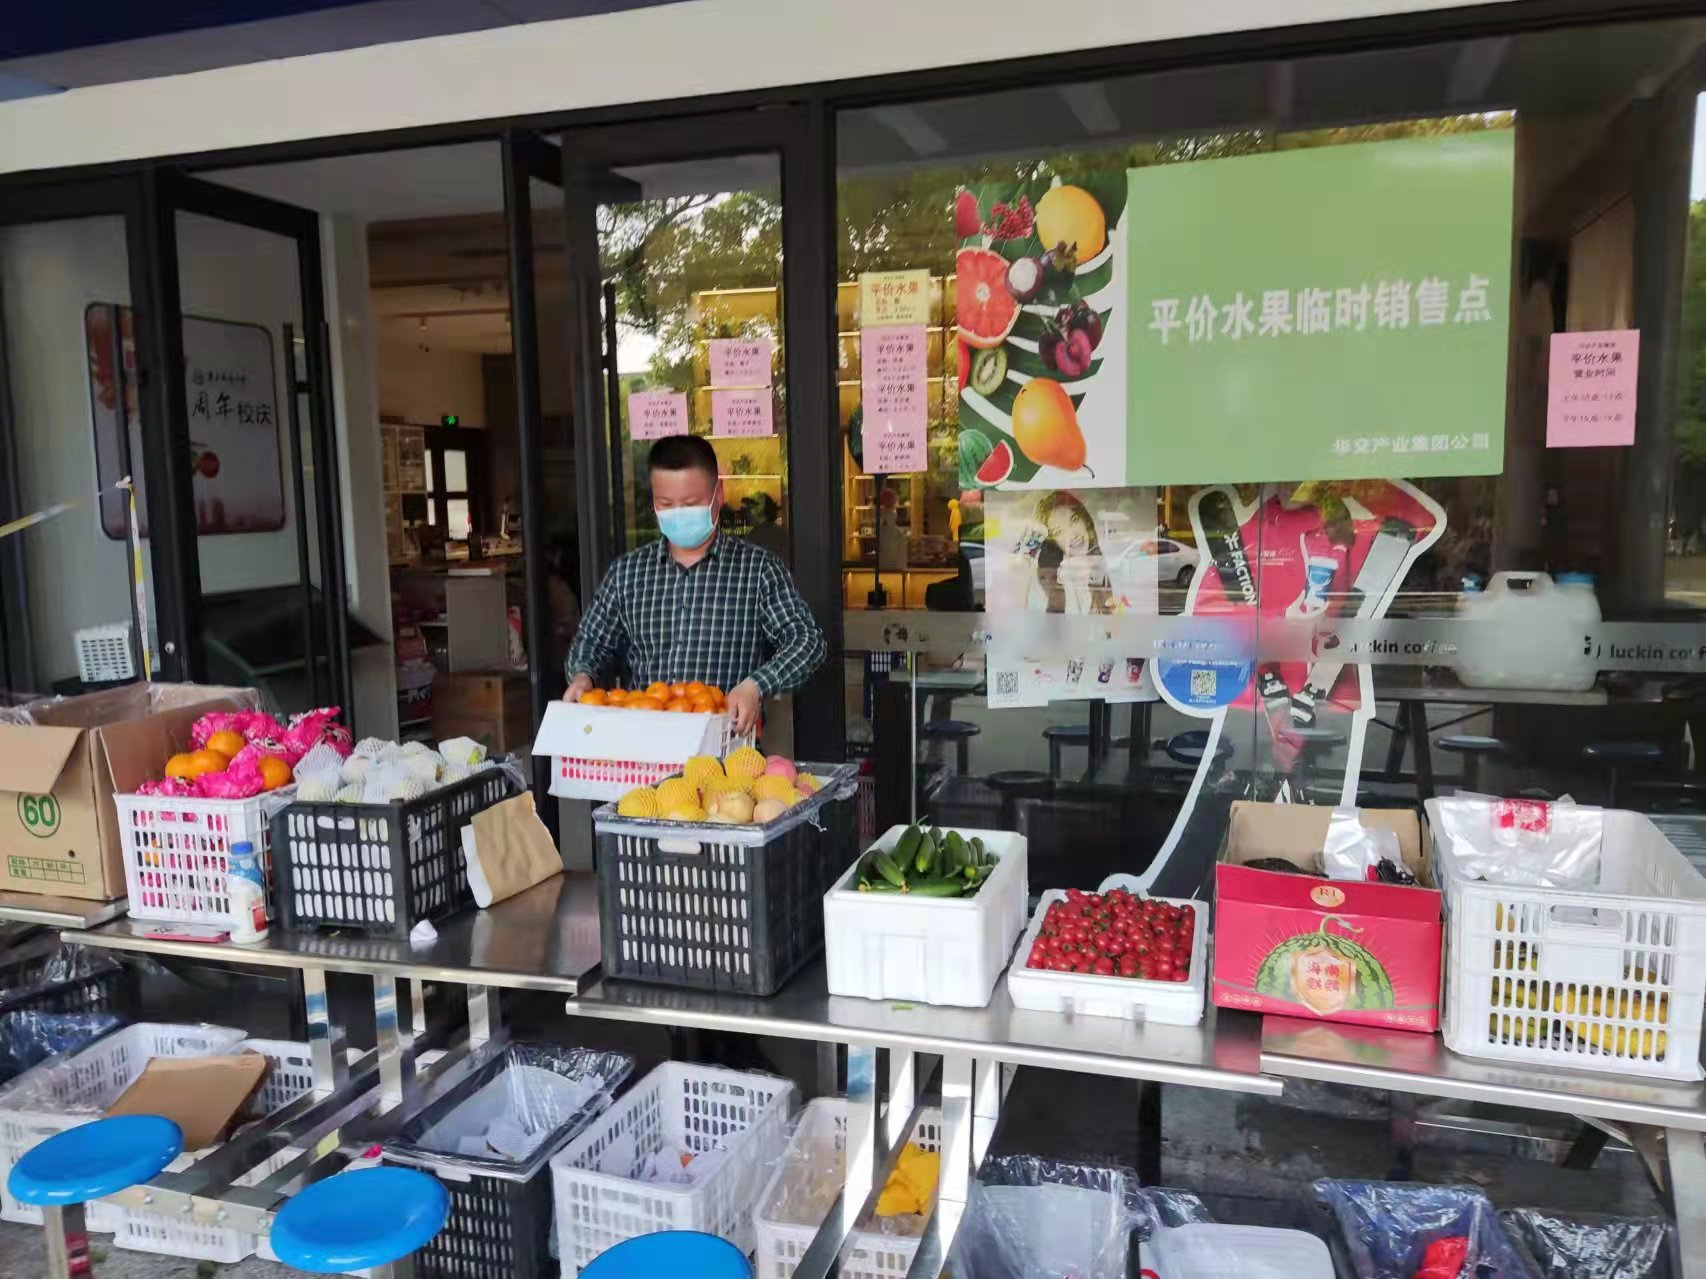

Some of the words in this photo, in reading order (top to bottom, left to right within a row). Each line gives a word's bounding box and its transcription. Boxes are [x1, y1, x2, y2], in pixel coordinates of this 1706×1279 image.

[1149, 273, 1492, 345] 平价水果临时销售点
[1571, 352, 1622, 364] 平价水果
[1230, 550, 1258, 605] FACTION
[1610, 644, 1663, 659] luckin
[23, 795, 56, 827] 60
